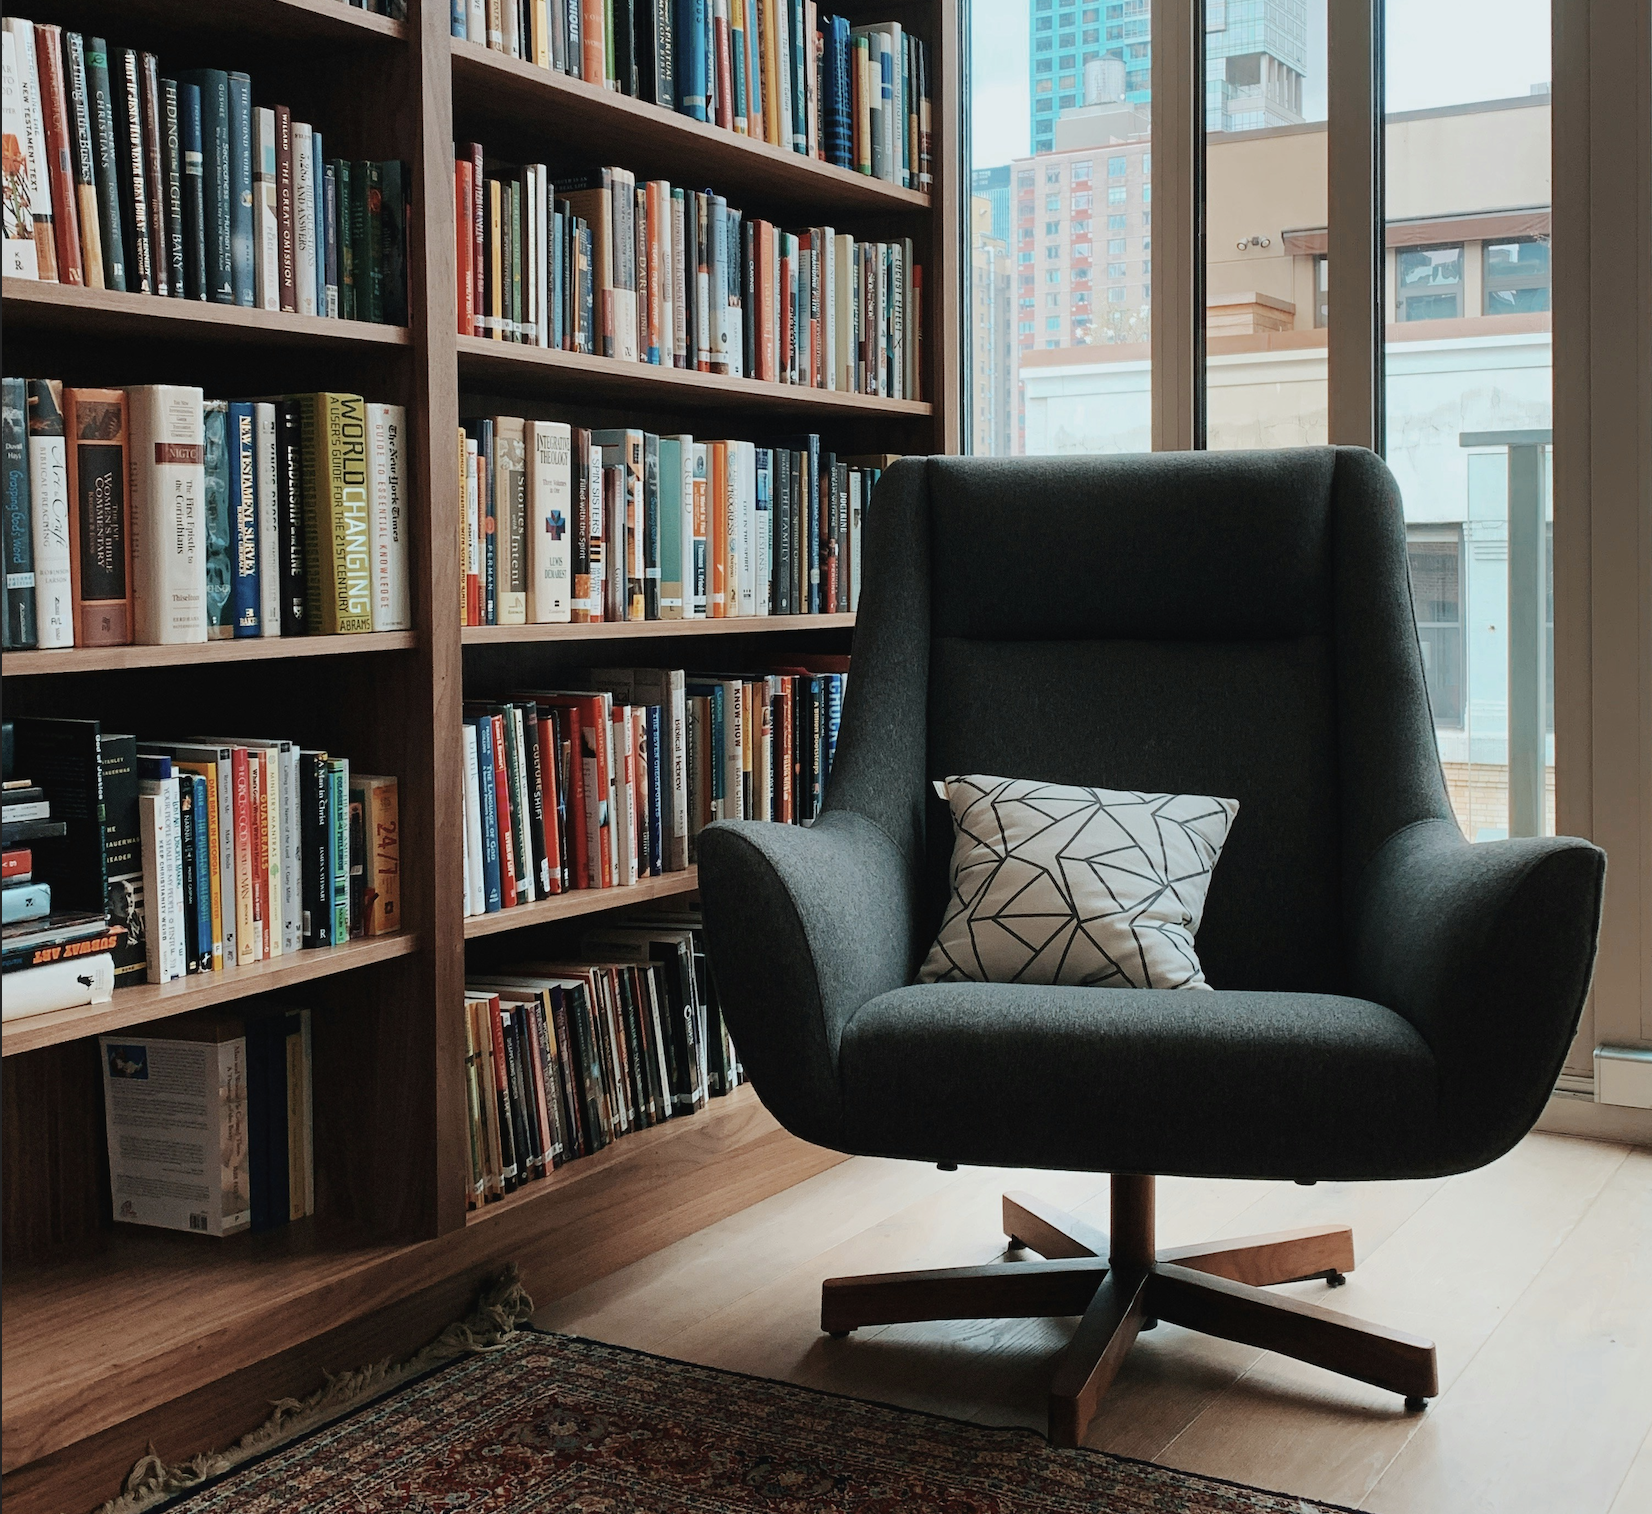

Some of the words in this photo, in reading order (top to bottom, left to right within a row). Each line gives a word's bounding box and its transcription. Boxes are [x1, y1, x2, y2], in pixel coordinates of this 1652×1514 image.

[70, 38, 83, 60] The
[71, 63, 87, 99] Thing
[96, 91, 109, 168] CHRISTIANS
[166, 87, 178, 148] HIDING
[24, 107, 36, 171] TESTAMENT
[79, 140, 93, 181] Bushes
[170, 172, 181, 221] LIGHT
[675, 210, 684, 248] EXPLORING
[172, 234, 183, 271] BARY
[283, 230, 292, 287] OMISSION
[676, 250, 684, 266] NEW
[639, 257, 647, 296] DARE
[676, 267, 684, 303] TESTAMENT
[330, 396, 339, 404] A
[242, 416, 251, 445] NEW
[331, 408, 340, 446] USER'S
[376, 424, 385, 457] GUIDE
[388, 424, 397, 446] The
[51, 446, 64, 487] Art
[170, 448, 197, 459] NIGTC
[332, 449, 341, 483] GUIDE
[377, 463, 385, 475] TO
[389, 449, 398, 474] New
[541, 450, 568, 465] THEOLOGY
[5, 470, 23, 510] Grasping
[104, 472, 113, 535] WOMEN'S
[242, 450, 254, 525] TESTAMENT
[287, 446, 301, 527] LEADERSHIP
[334, 486, 342, 507] FOR
[388, 476, 400, 504] York
[41, 492, 50, 547] PREACHING
[48, 499, 67, 549] Craft
[95, 477, 105, 567] COMMENTARY
[186, 498, 195, 520] First
[335, 510, 344, 532] THE
[341, 398, 370, 614] WORLDCHANGING
[378, 482, 388, 538] ESSENTIAL
[391, 506, 400, 542] Times
[592, 488, 600, 534] SISTERS
[175, 495, 185, 555] Corinthians
[185, 523, 196, 554] Epistle
[12, 539, 25, 564] Word
[105, 537, 113, 573] BIBLE
[243, 527, 255, 576] SURVEY
[291, 546, 302, 576] LINE
[335, 534, 345, 561] 21ST
[511, 534, 520, 585] Intent
[337, 564, 348, 613] CENTURY
[379, 545, 389, 609] KNOWLEDGE
[172, 593, 199, 602] Thiselton
[340, 618, 371, 632] ABRAMS
[468, 741, 478, 780] blink
[238, 777, 246, 807] GRACE
[319, 789, 326, 798] in
[238, 816, 248, 841] GOD
[319, 800, 328, 825] Christ
[211, 828, 216, 837] IN
[260, 794, 269, 869] GUARDRAILS
[377, 821, 398, 876] 24/7
[490, 828, 495, 838] OF
[33, 947, 62, 964] ART
[63, 936, 118, 958] SUBWAY
